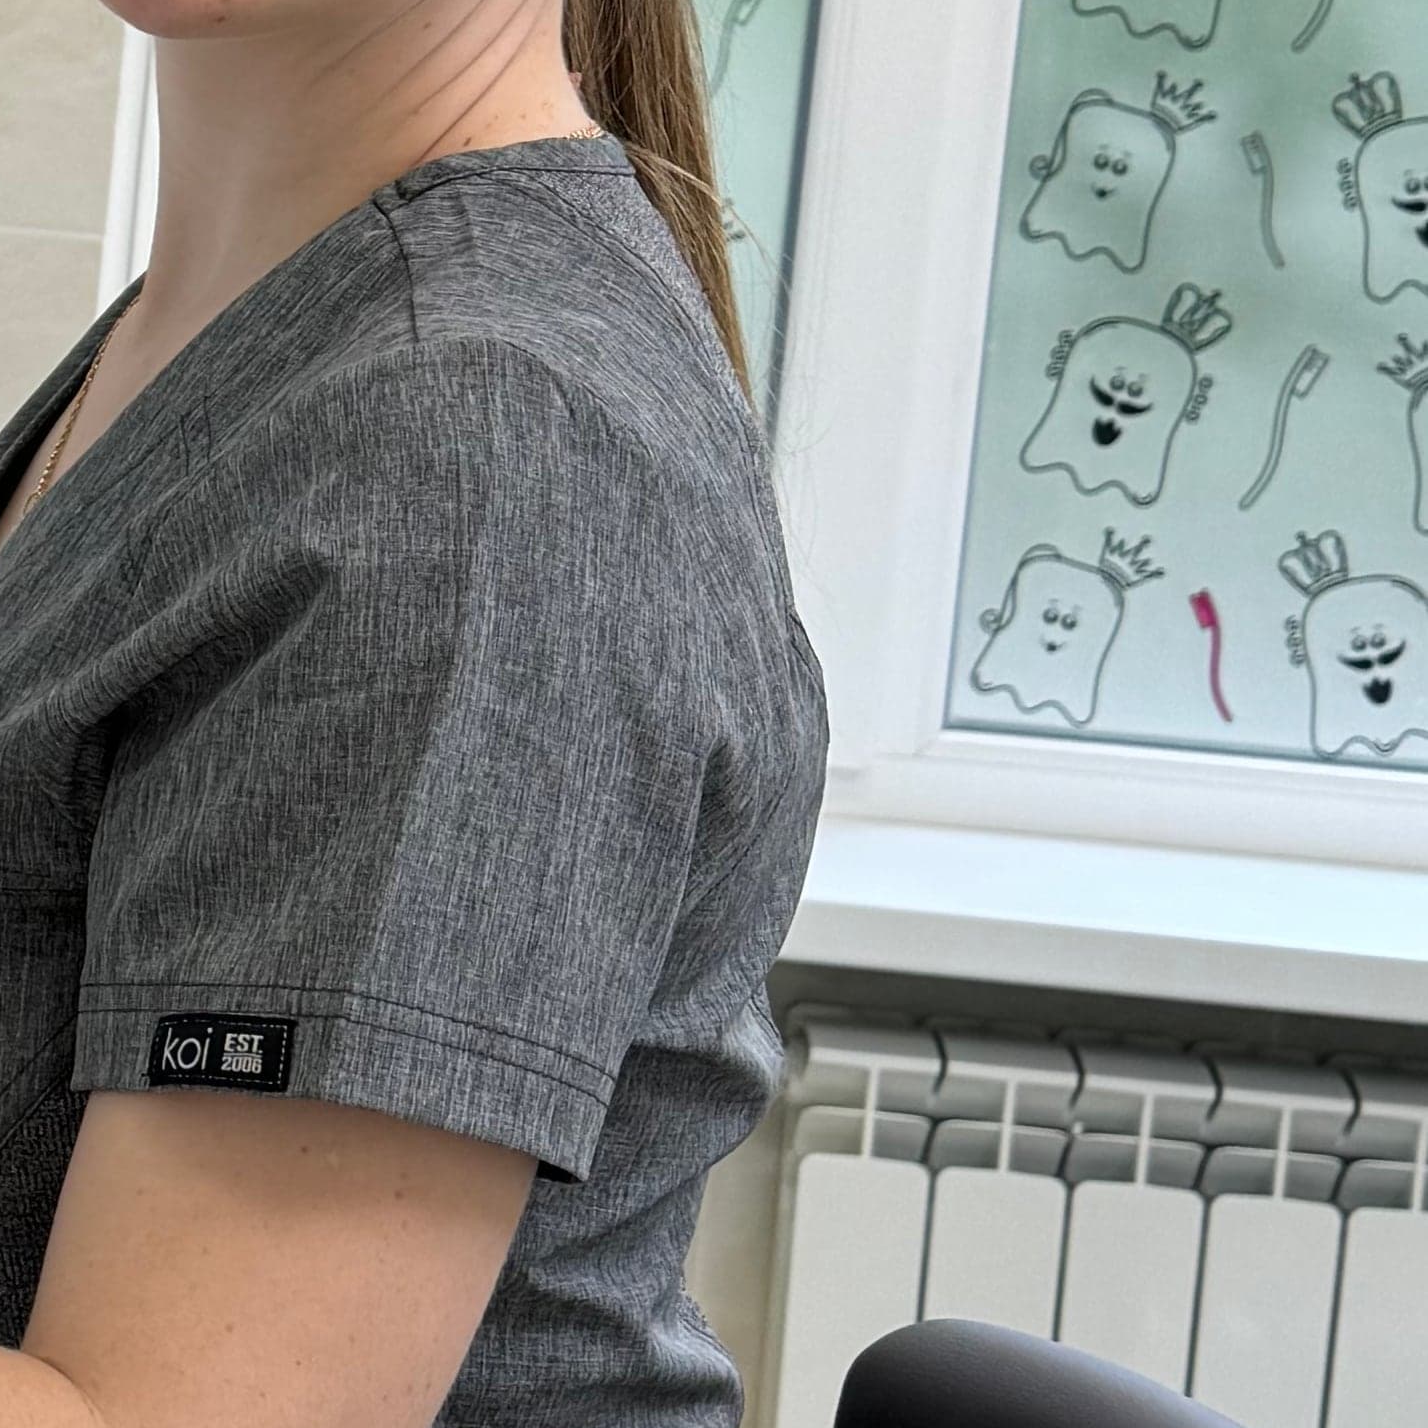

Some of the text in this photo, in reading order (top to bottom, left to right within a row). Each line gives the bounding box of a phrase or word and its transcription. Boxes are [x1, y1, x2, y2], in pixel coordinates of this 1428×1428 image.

[162, 1027, 213, 1070] koi
[224, 1033, 264, 1054] EST.
[221, 1055, 263, 1073] 2006
